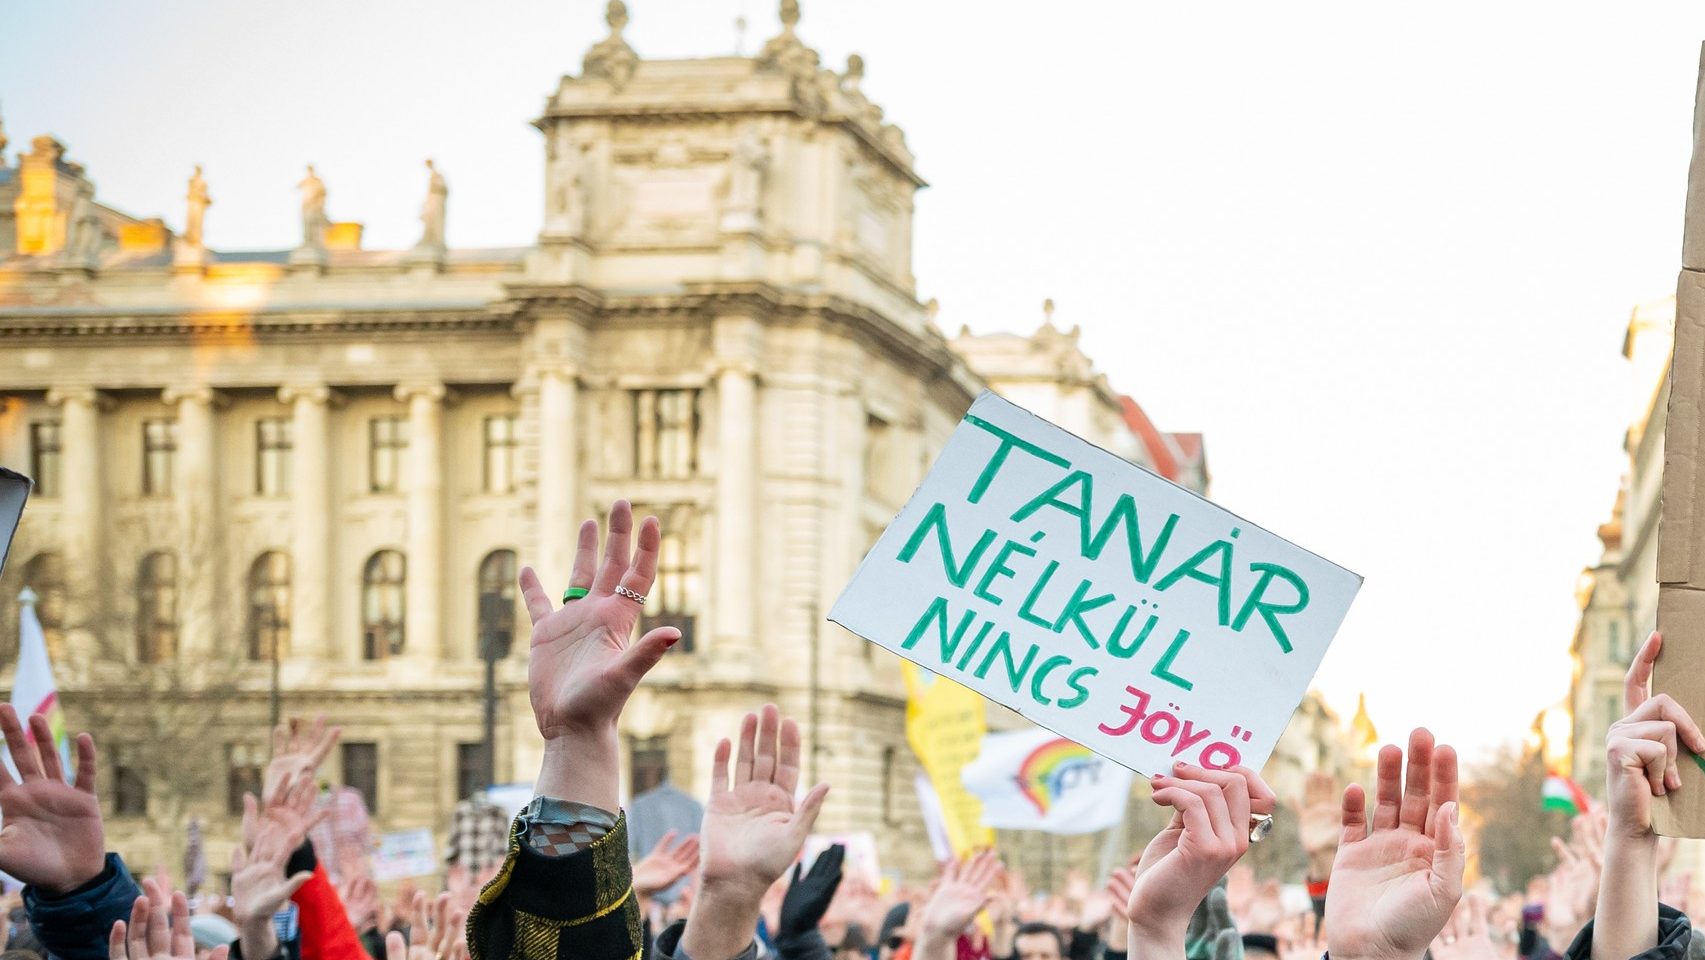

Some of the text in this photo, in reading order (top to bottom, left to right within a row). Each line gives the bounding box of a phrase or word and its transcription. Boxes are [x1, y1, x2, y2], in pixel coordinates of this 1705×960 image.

[895, 501, 1194, 692] NÉLKÜL
[963, 412, 1311, 655] TANÁR
[901, 596, 1099, 709] NINCS
